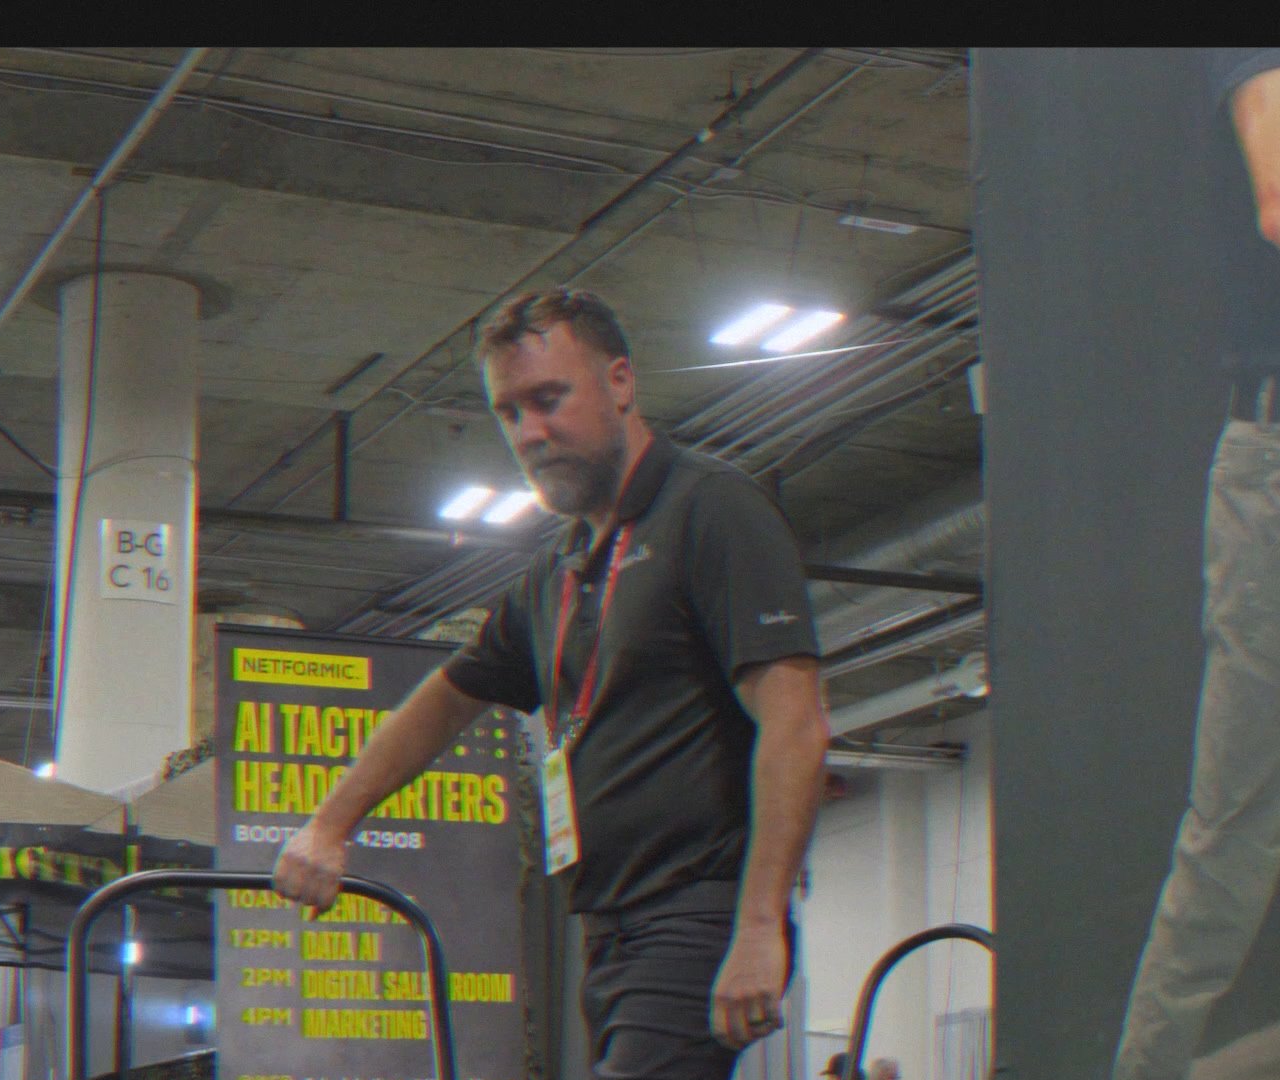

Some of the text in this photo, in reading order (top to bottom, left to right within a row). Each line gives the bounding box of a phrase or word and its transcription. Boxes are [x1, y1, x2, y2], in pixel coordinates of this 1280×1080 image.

[109, 563, 170, 591] C 16
[234, 701, 395, 757] AI TACTI
[234, 760, 507, 825] HEADARTERS
[234, 824, 303, 844] BOOT
[354, 830, 425, 850] 42908
[231, 928, 383, 962] 12PM DATA AI
[241, 967, 296, 988] 2PM
[301, 969, 381, 1001] DIGITAL
[448, 972, 515, 1003] ROOM
[242, 1007, 431, 1041] 4PM MARKETING
